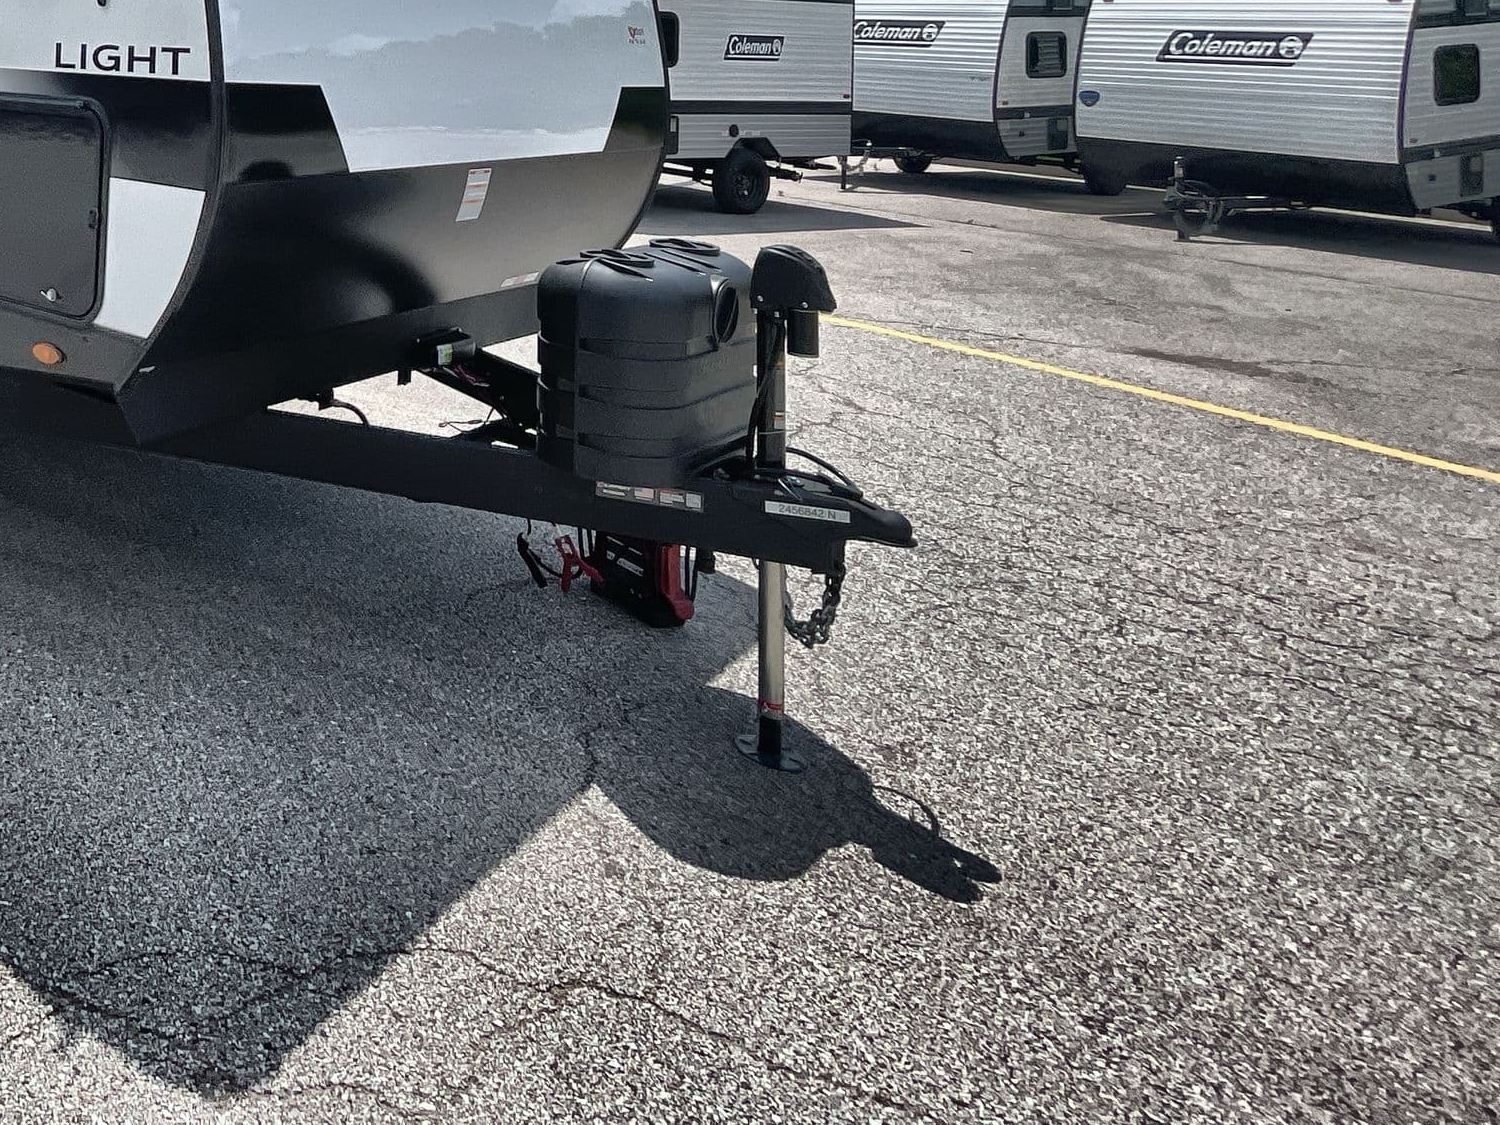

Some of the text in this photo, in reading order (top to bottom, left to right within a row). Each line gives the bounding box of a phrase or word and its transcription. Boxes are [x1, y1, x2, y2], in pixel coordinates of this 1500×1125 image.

[854, 21, 921, 39] Coleman
[729, 36, 772, 54] Coleman
[1169, 32, 1277, 56] Coleman
[55, 42, 191, 75] LIGHT
